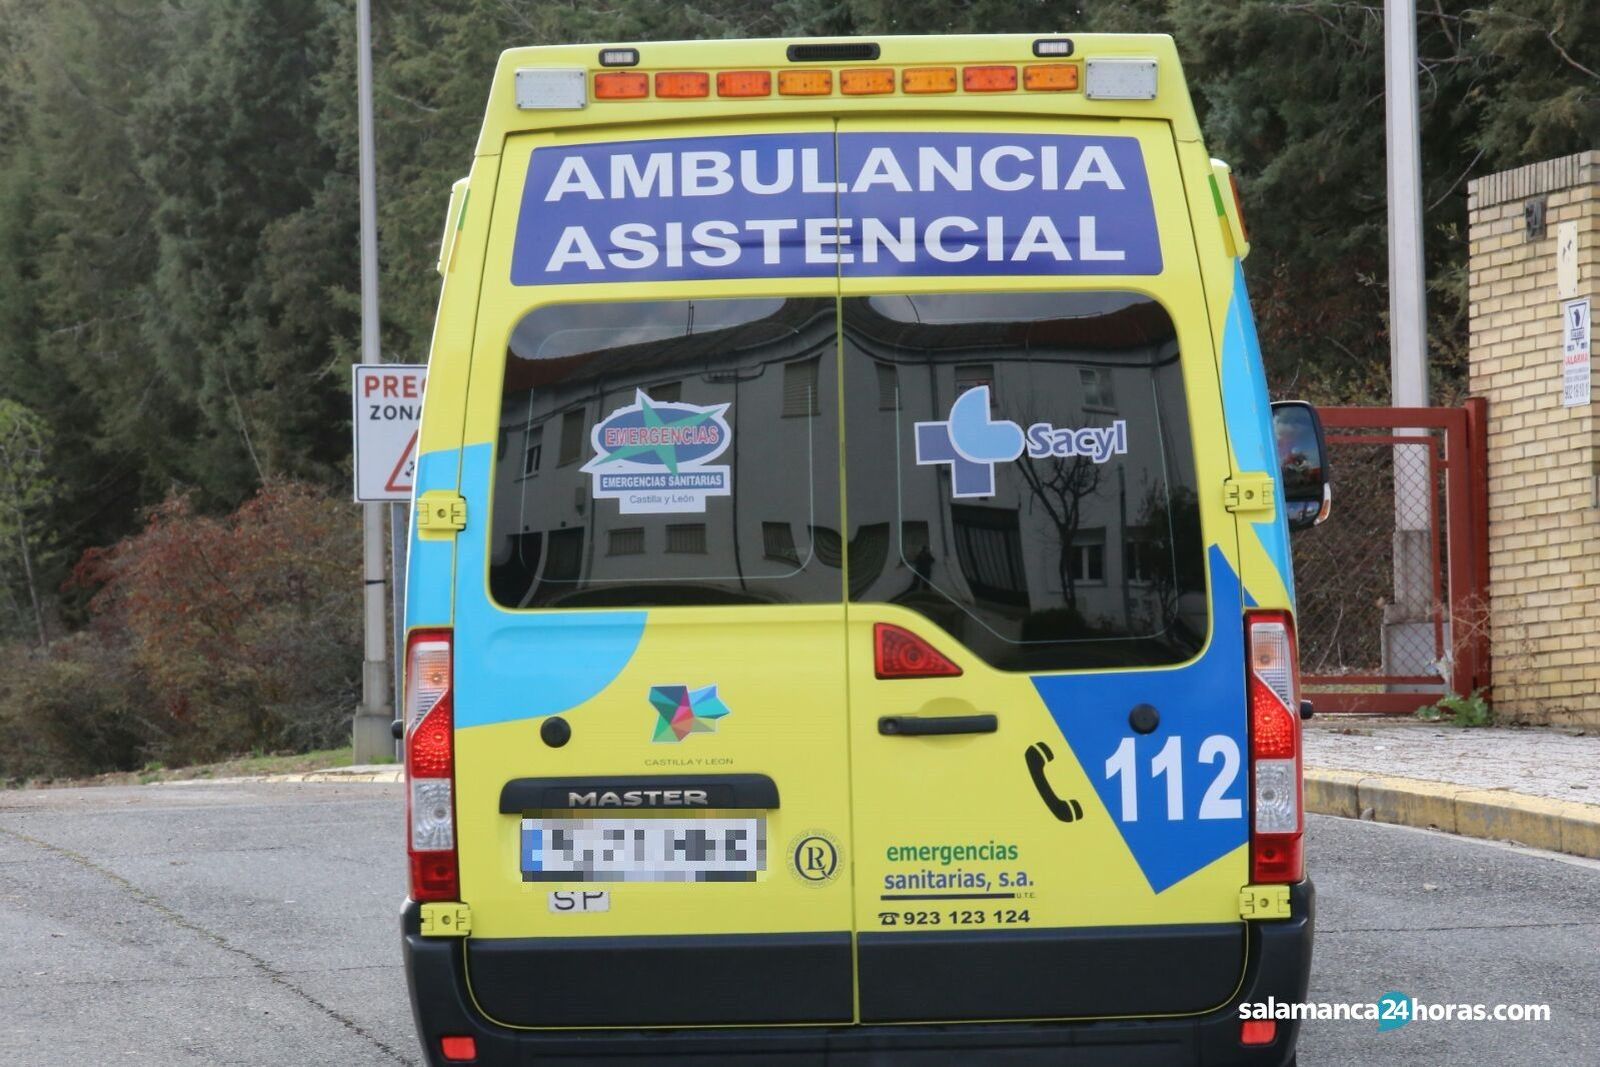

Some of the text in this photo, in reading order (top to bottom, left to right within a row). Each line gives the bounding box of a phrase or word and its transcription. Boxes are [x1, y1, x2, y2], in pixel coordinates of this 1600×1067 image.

[544, 145, 1125, 201] AMBULANCIA
[545, 215, 1125, 272] ASISTENCIAL
[364, 375, 427, 398] PRE
[605, 426, 719, 447] EMERGENCIAS
[1028, 421, 1126, 462] Sacyl
[602, 475, 722, 488] EMERGENCIAS SANITARIAS
[629, 494, 694, 505] Castilla y León
[644, 758, 694, 766] CASTILLA
[695, 758, 702, 766] Y
[1105, 734, 1242, 822] 112
[568, 790, 708, 807] MASTER
[886, 841, 1018, 865] emergencias
[884, 869, 1034, 891] sanitarias, s.a.
[903, 909, 1030, 925] 923 123 124
